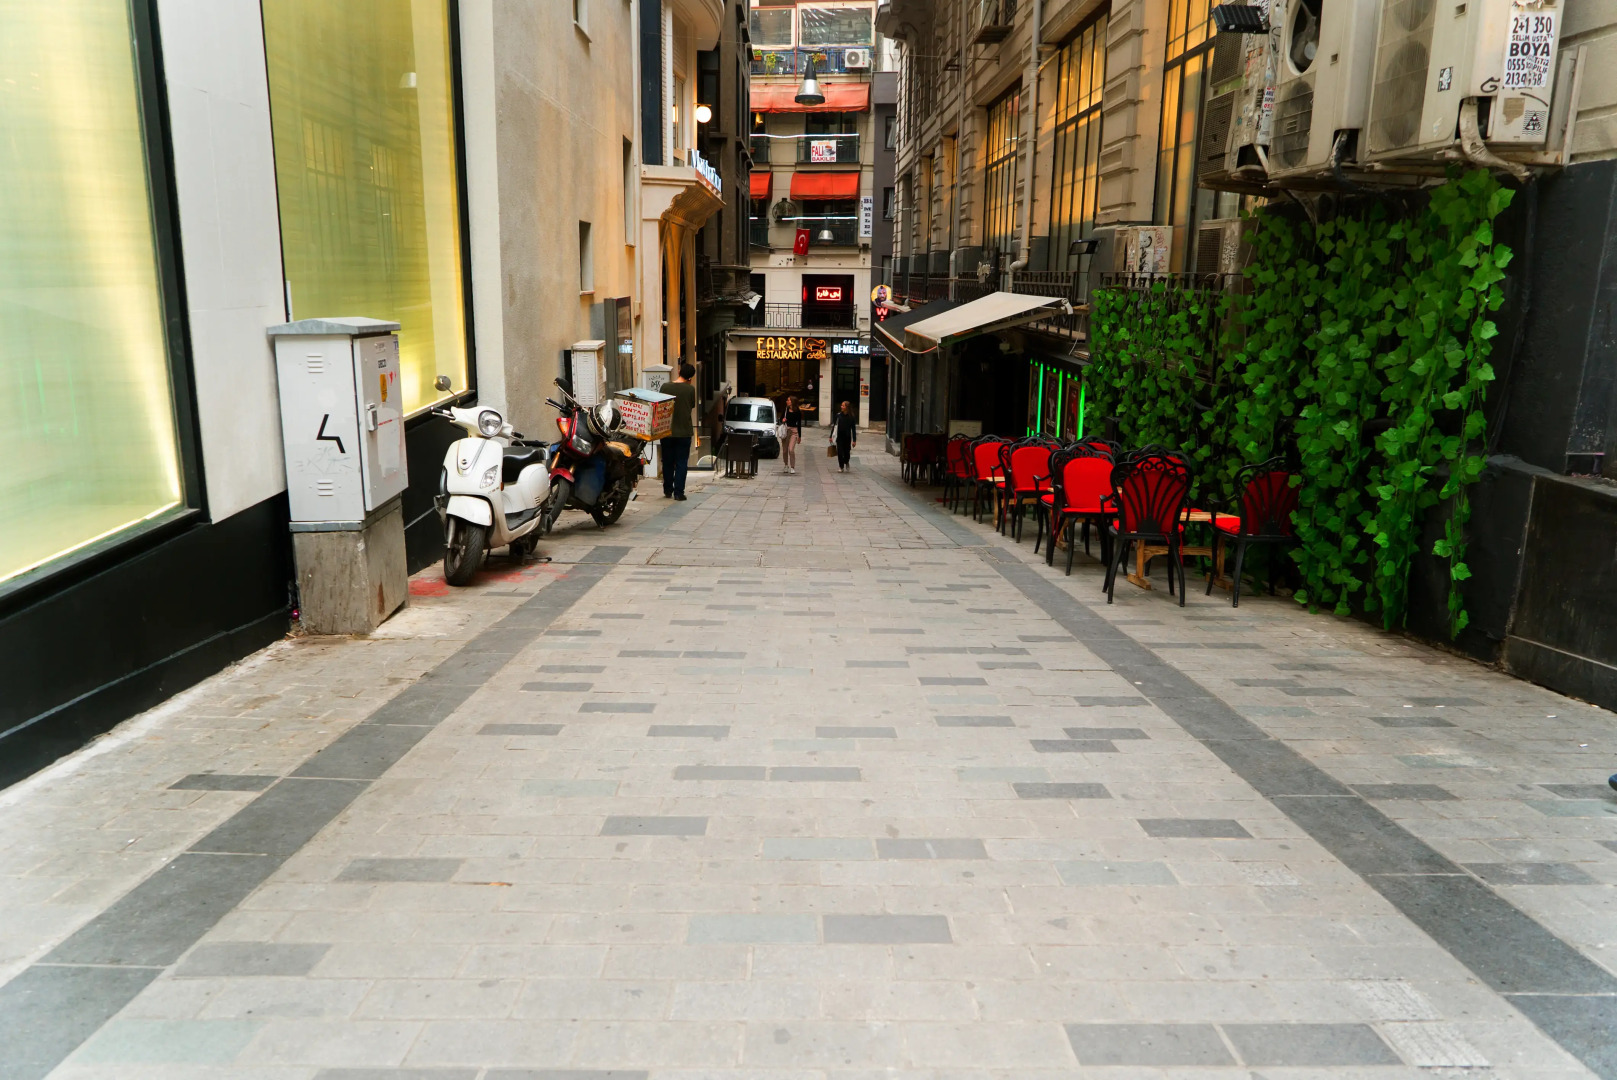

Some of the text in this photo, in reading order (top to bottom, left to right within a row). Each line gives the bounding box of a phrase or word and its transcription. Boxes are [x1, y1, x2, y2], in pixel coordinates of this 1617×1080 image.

[1512, 16, 1552, 33] 2+1 350
[1510, 42, 1550, 57] BOYA
[1507, 58, 1526, 71] 0555
[757, 337, 803, 350] FARSI
[756, 350, 803, 360] RESTAURANT
